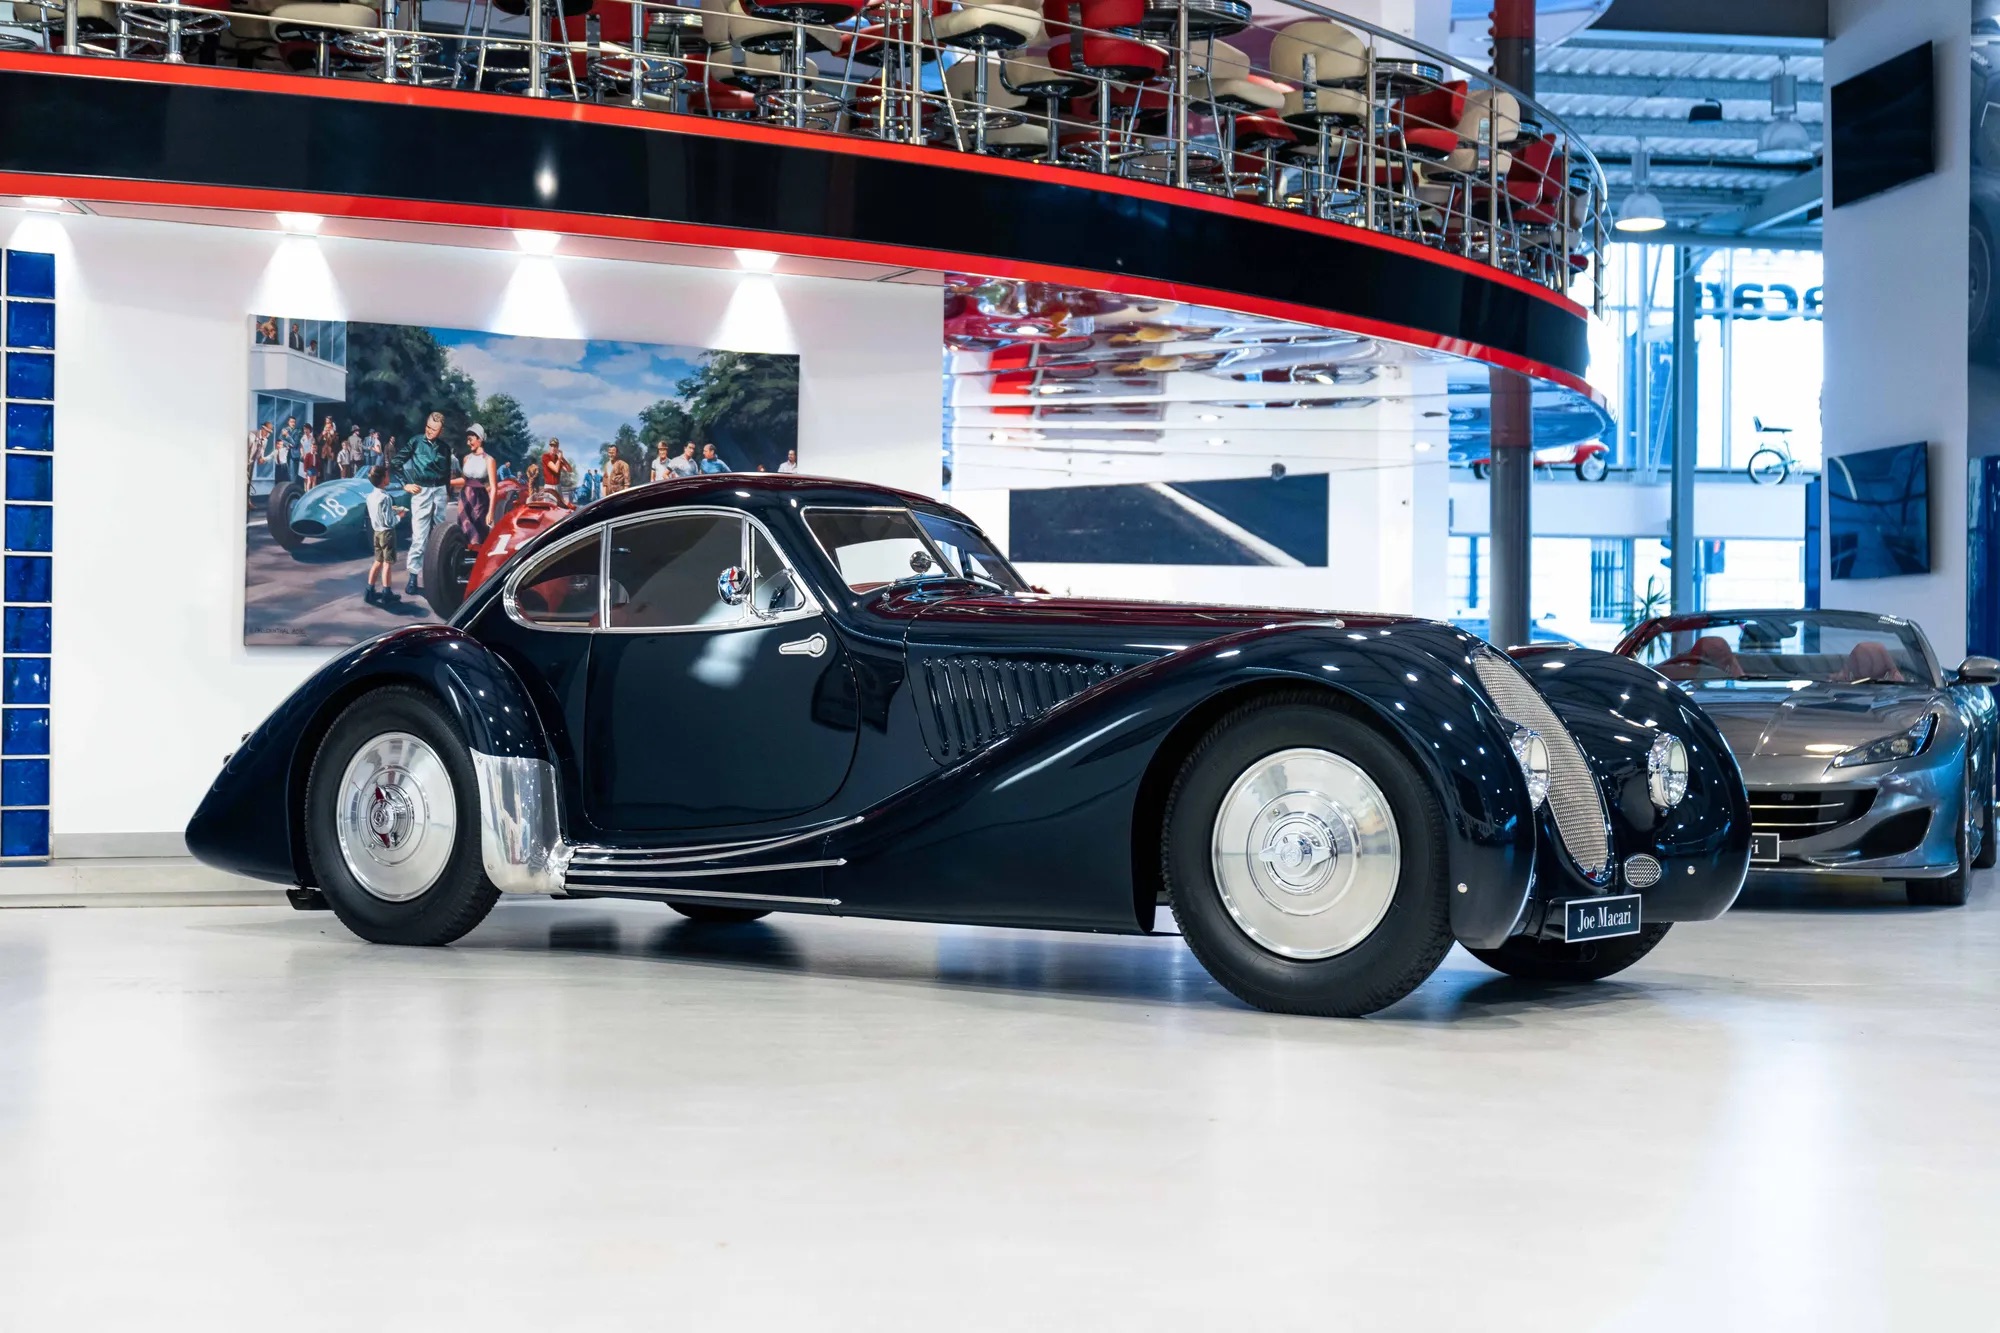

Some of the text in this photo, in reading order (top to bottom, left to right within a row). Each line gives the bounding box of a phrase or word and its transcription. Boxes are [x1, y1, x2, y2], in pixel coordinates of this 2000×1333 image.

[319, 497, 347, 518] 18
[1577, 904, 1631, 933] Joe Macari
